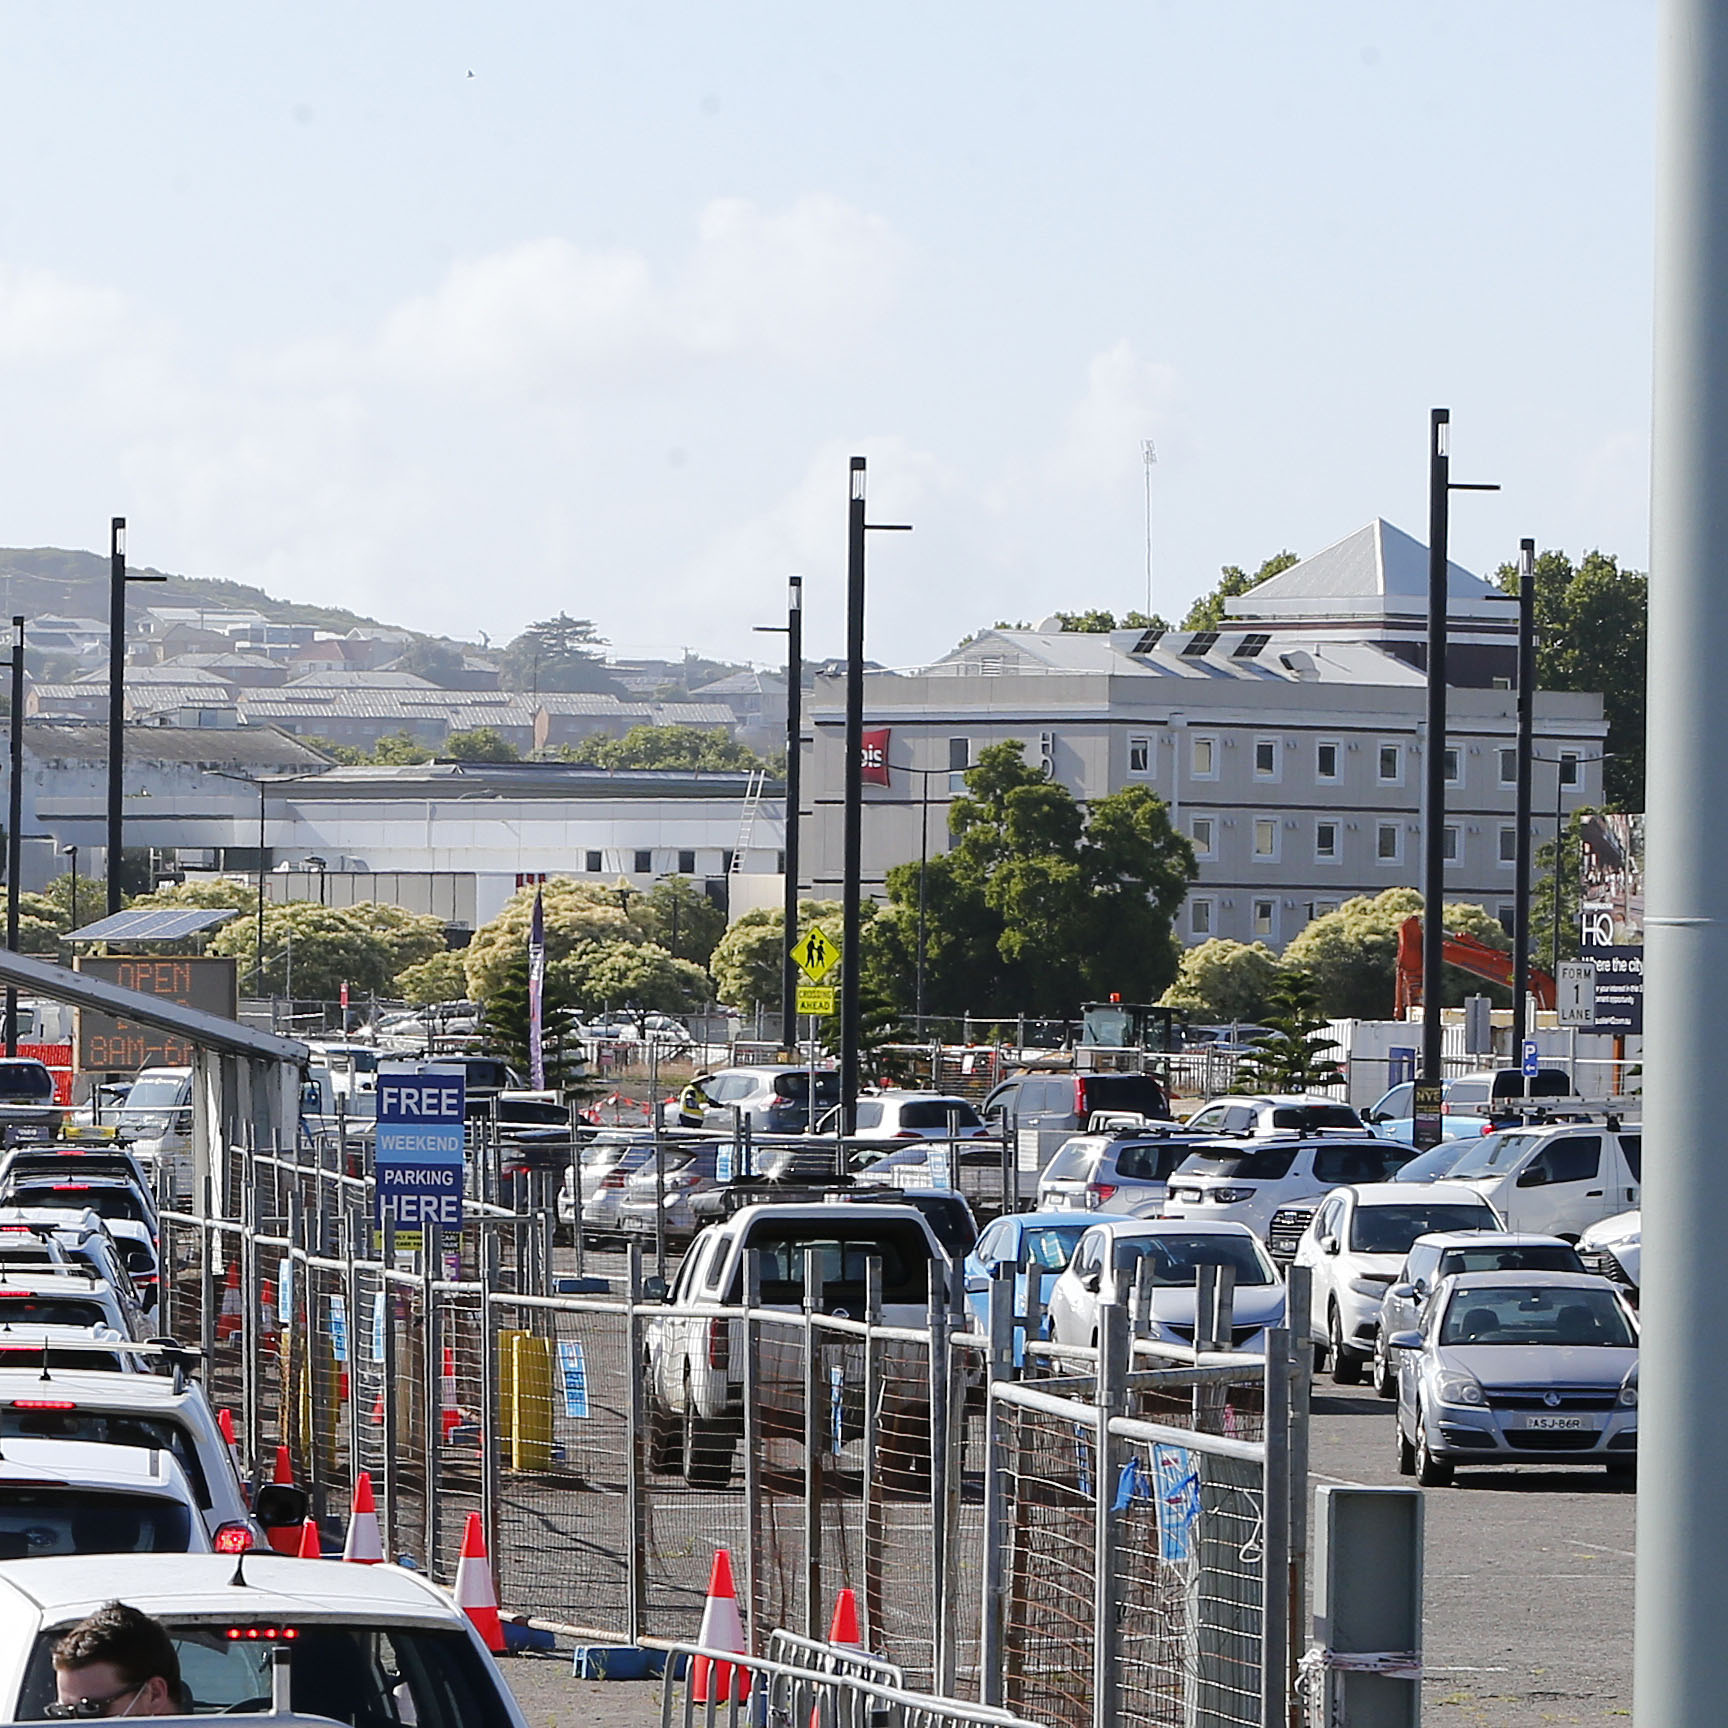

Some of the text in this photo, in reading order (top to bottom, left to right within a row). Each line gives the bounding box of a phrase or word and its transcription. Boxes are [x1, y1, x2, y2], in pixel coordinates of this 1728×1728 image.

[1582, 914, 1614, 946] HQ
[118, 963, 191, 993] OPEN
[1562, 968, 1591, 980] FORM
[1574, 984, 1579, 1005] 1
[801, 1002, 830, 1010] AHEAD
[1561, 1009, 1591, 1020] LANE
[1525, 1045, 1536, 1060] P
[382, 1088, 459, 1116] FREE
[381, 1136, 458, 1151] WEEKEND
[384, 1170, 454, 1186] PARKING
[380, 1195, 458, 1222] HERE
